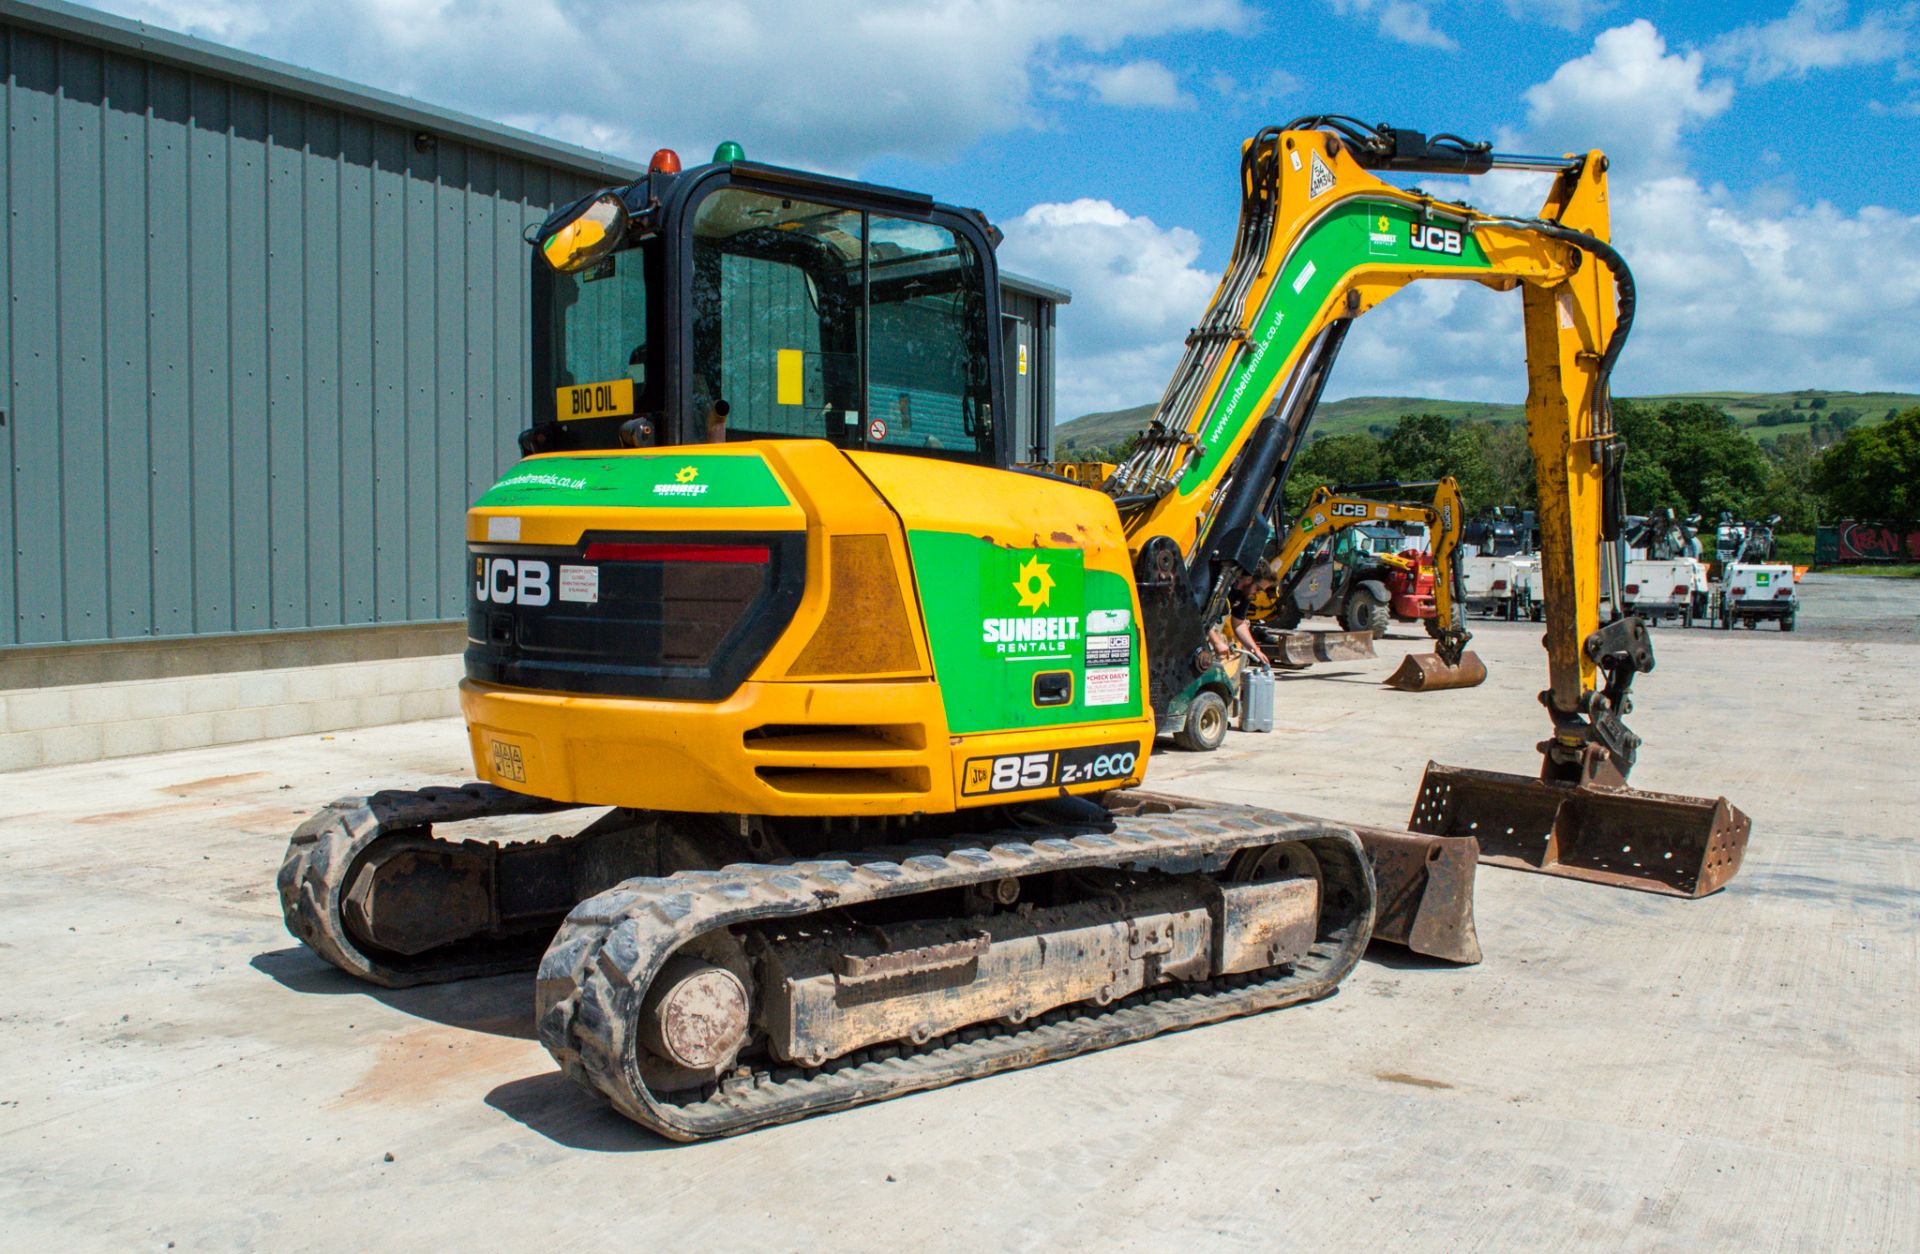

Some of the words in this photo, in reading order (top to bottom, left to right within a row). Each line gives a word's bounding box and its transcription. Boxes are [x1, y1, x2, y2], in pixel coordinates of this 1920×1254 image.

[1369, 232, 1397, 243] SUNBELT
[1411, 225, 1462, 254] JCB
[1210, 310, 1285, 444] www.sunbeltrentals.co.uk
[572, 387, 592, 414] BIO
[595, 385, 617, 412] OIL
[652, 484, 708, 494] SUNBELT
[1331, 503, 1368, 517] JCB
[476, 558, 551, 607] JCB
[983, 617, 1079, 642] SUNBELT
[997, 641, 1066, 653] RENTALS
[1110, 637, 1128, 647] JCB
[972, 767, 987, 785] JCB
[991, 753, 1050, 791] 85
